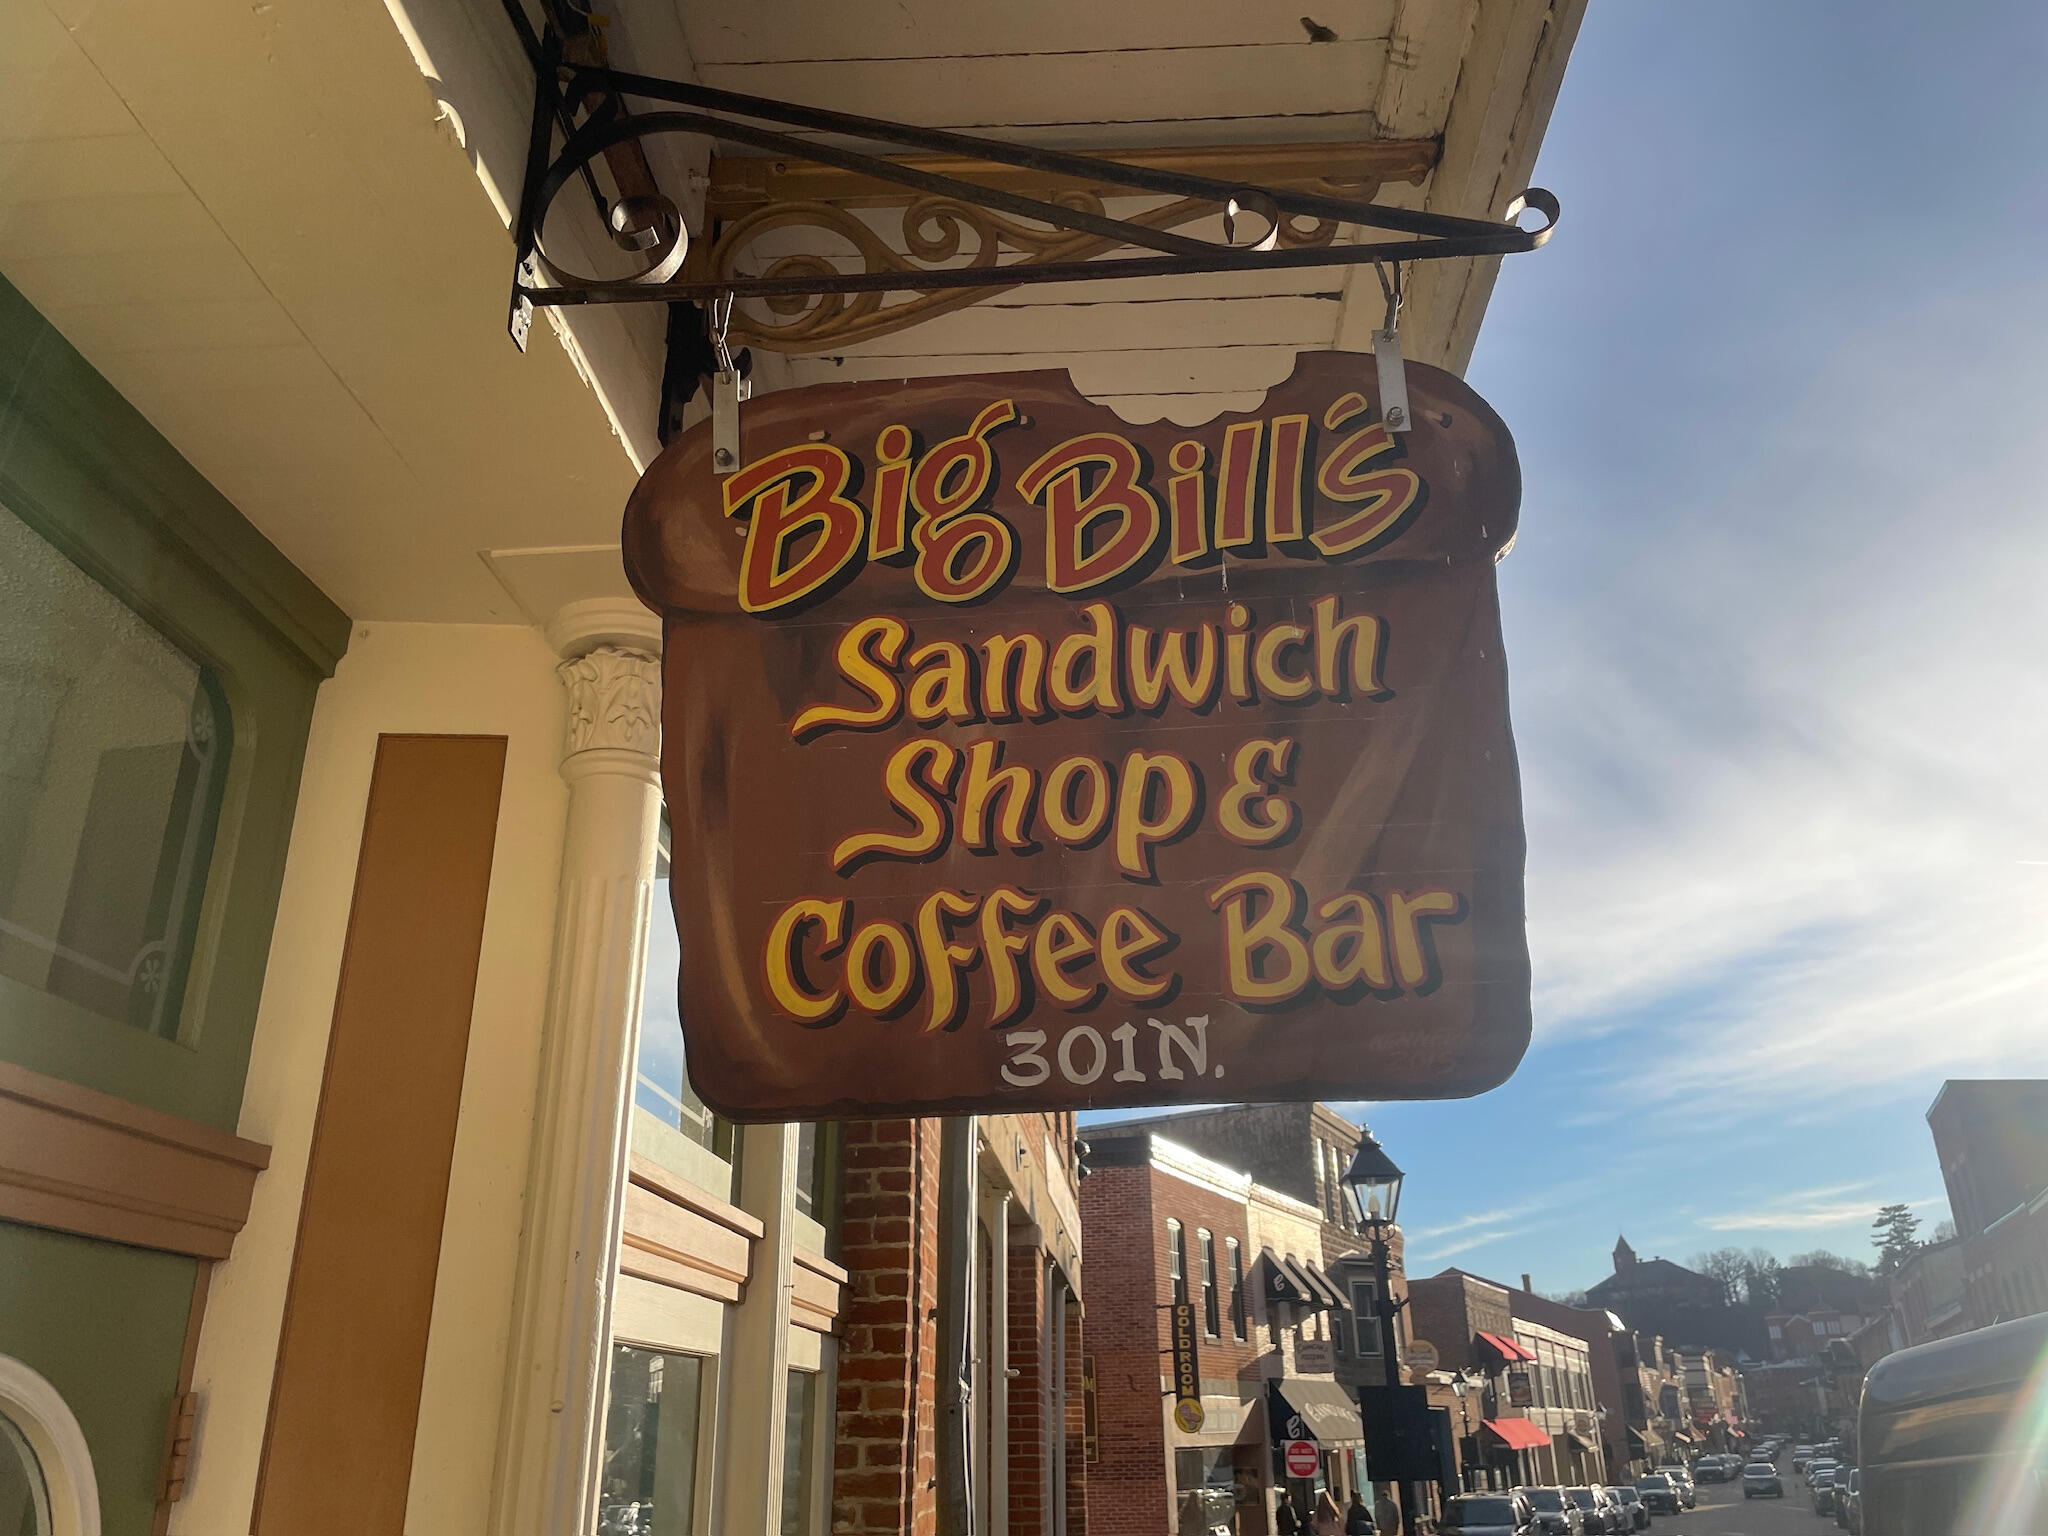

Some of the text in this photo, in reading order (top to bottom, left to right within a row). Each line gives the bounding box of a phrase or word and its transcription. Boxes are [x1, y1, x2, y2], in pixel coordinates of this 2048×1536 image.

[723, 391, 1421, 613] Big Bill's
[791, 594, 1386, 737] Sandwich
[832, 737, 1296, 881] Shop &
[764, 869, 1466, 1034] Coffee Bar
